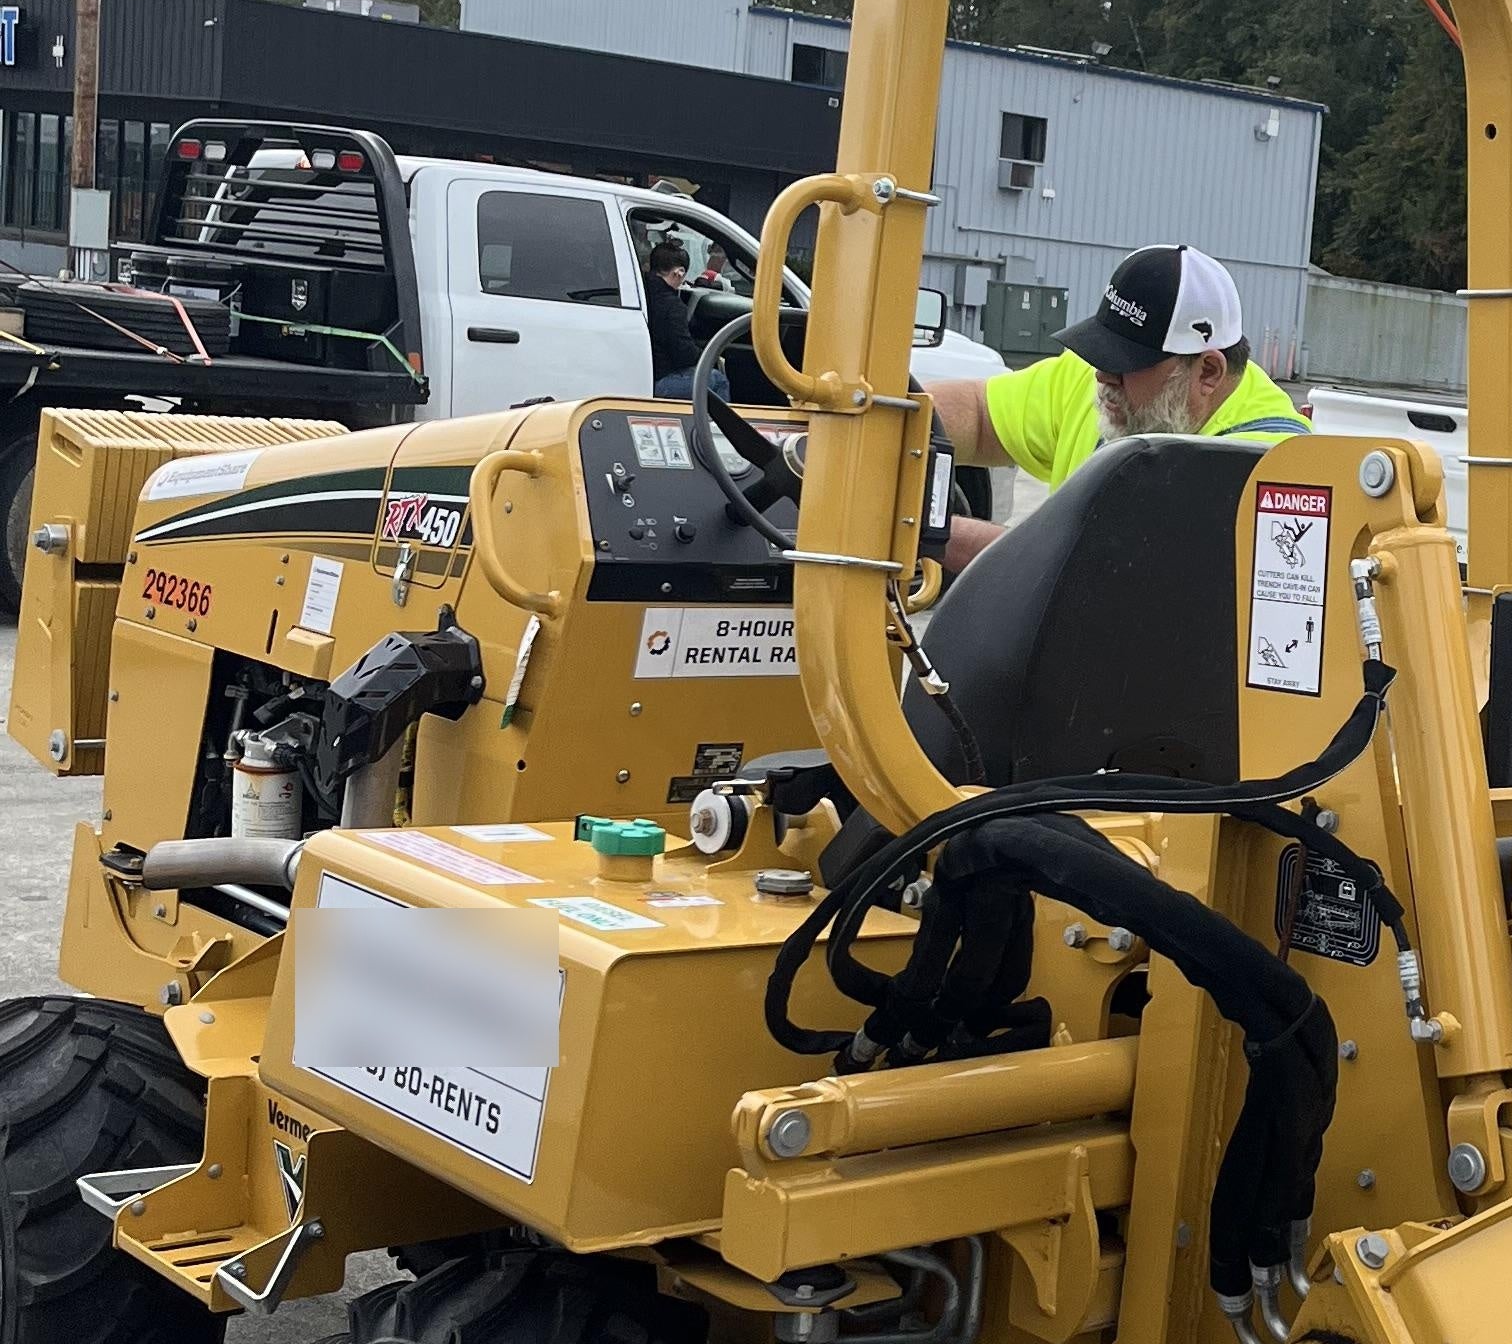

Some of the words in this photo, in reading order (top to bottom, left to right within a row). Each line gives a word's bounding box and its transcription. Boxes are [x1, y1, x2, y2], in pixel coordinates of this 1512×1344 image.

[383, 493, 429, 543] RTX
[418, 506, 461, 548] 450
[1274, 492, 1327, 513] DANGER
[142, 568, 212, 616] 292366
[716, 621, 794, 637] 8-HOUR
[685, 647, 762, 664] RENTAL
[268, 1098, 317, 1143] Verme
[394, 1067, 501, 1134] 80-RENTS
